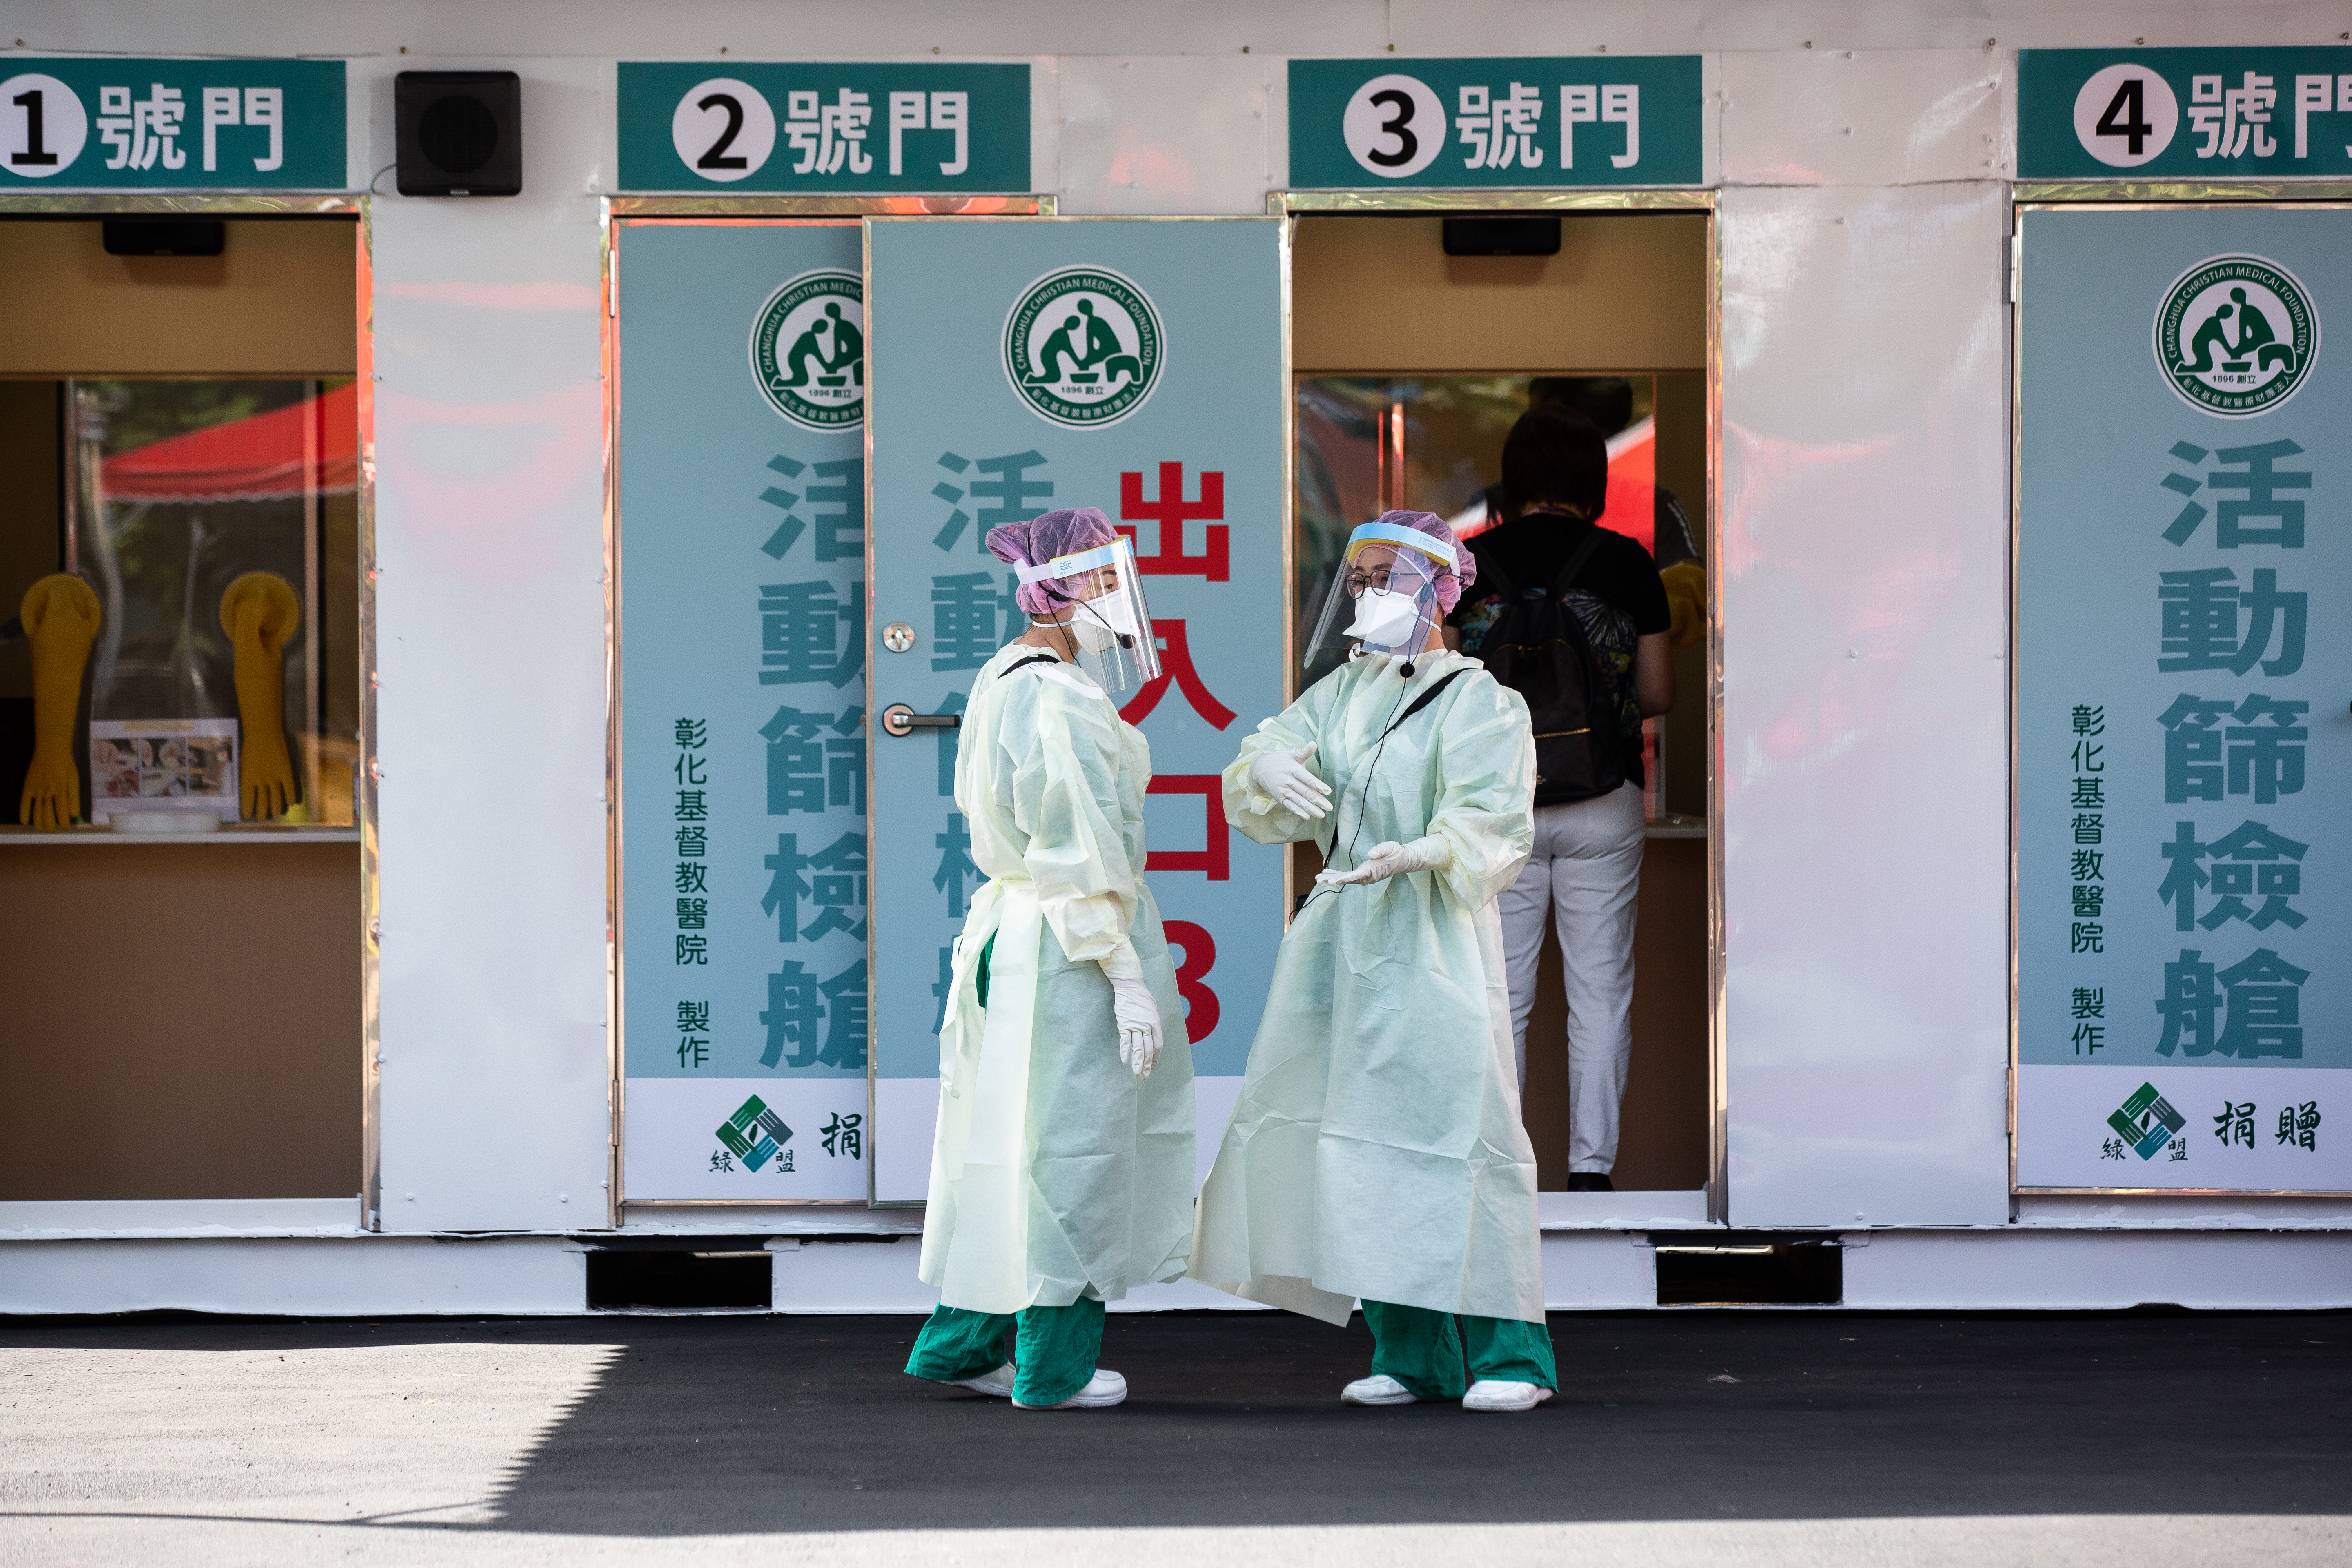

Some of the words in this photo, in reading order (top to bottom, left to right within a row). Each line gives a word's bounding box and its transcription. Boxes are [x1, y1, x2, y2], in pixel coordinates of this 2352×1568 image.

[762, 313, 781, 373] CHANGHUA
[777, 282, 827, 313] CHRISTIAN
[1015, 310, 1034, 369] CHANGHUA
[1030, 278, 1080, 310] CHRISTIAN
[1082, 278, 1126, 302] MEDICAL
[1125, 298, 1153, 366] FOUNDATION
[2167, 298, 2186, 358] CHANGHUA
[2183, 267, 2233, 298] CHRISTIAN
[2236, 266, 2280, 290] MEDICAL
[2280, 285, 2307, 354] FOUNDATION
[1085, 386, 1104, 395] 創立
[2212, 375, 2234, 383] 1896
[2236, 375, 2256, 384] 創立
[2155, 439, 2312, 1060] 活動篩檢艙
[675, 717, 708, 965] 彰化基督教醫院
[2071, 704, 2105, 953] 彰化基督教醫院
[677, 1000, 710, 1068] 製作
[2071, 987, 2105, 1056] 製作
[820, 1112, 862, 1160] 捐
[2213, 1100, 2321, 1152] 捐贈
